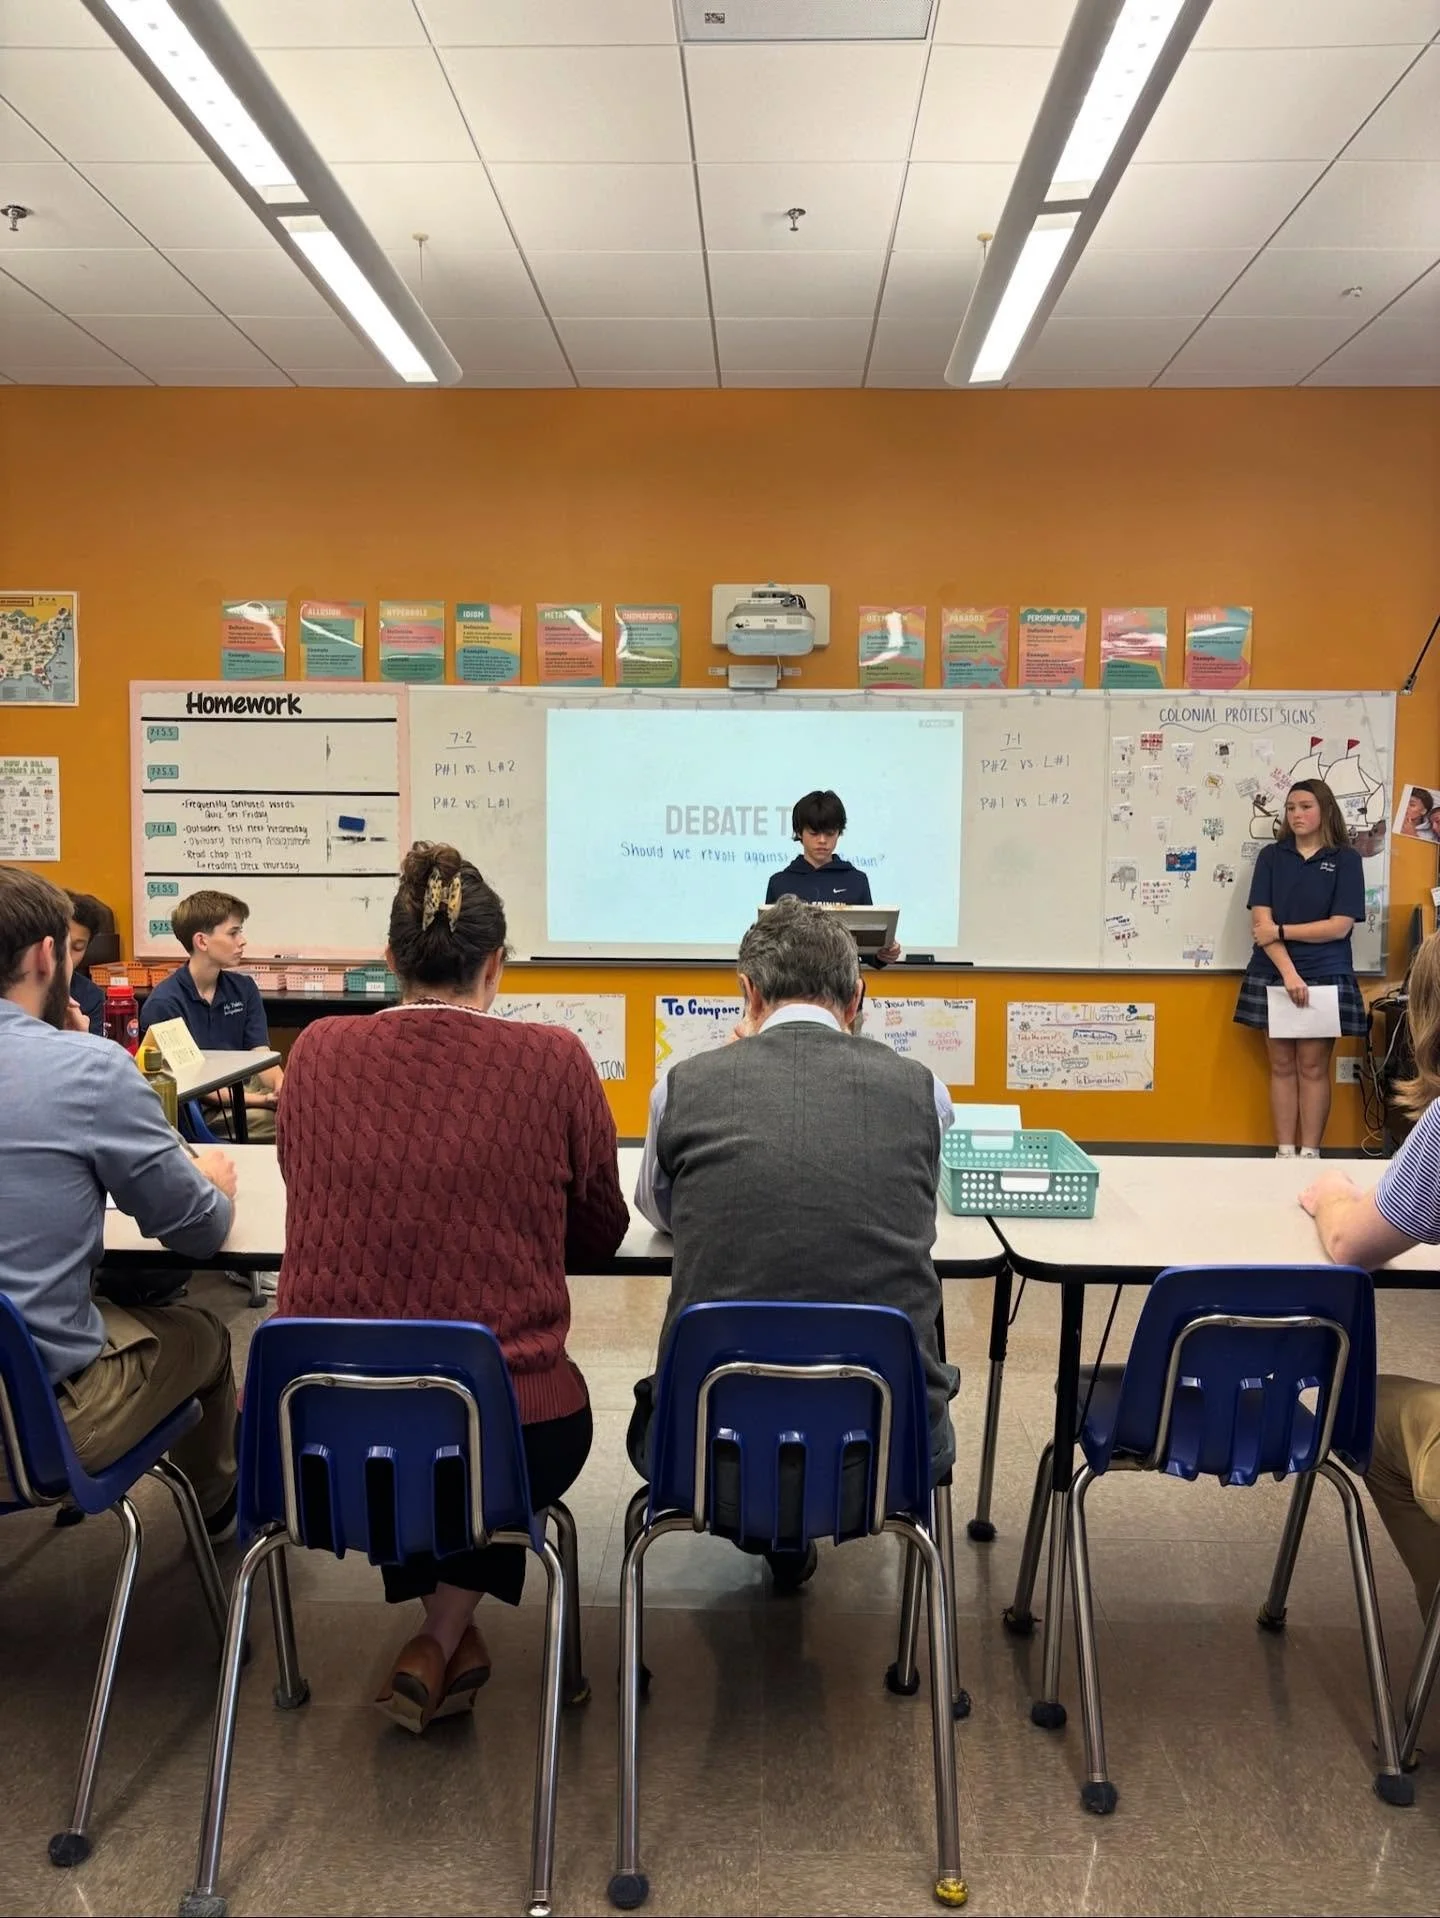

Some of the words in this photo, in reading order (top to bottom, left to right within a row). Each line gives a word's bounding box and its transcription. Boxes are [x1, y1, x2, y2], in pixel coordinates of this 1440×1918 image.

[463, 610, 485, 619] IDIOM
[1027, 614, 1080, 622] PERSONIFICATION
[186, 691, 303, 716] Homework
[1159, 707, 1218, 723] COLONIAL
[1225, 707, 1274, 724] PROTEST
[1280, 708, 1317, 725] SIGNS
[449, 730, 473, 744] 7-2
[665, 804, 768, 836] DEBATE
[620, 841, 664, 859] Should
[661, 998, 685, 1016] To
[688, 998, 741, 1020] Compare
